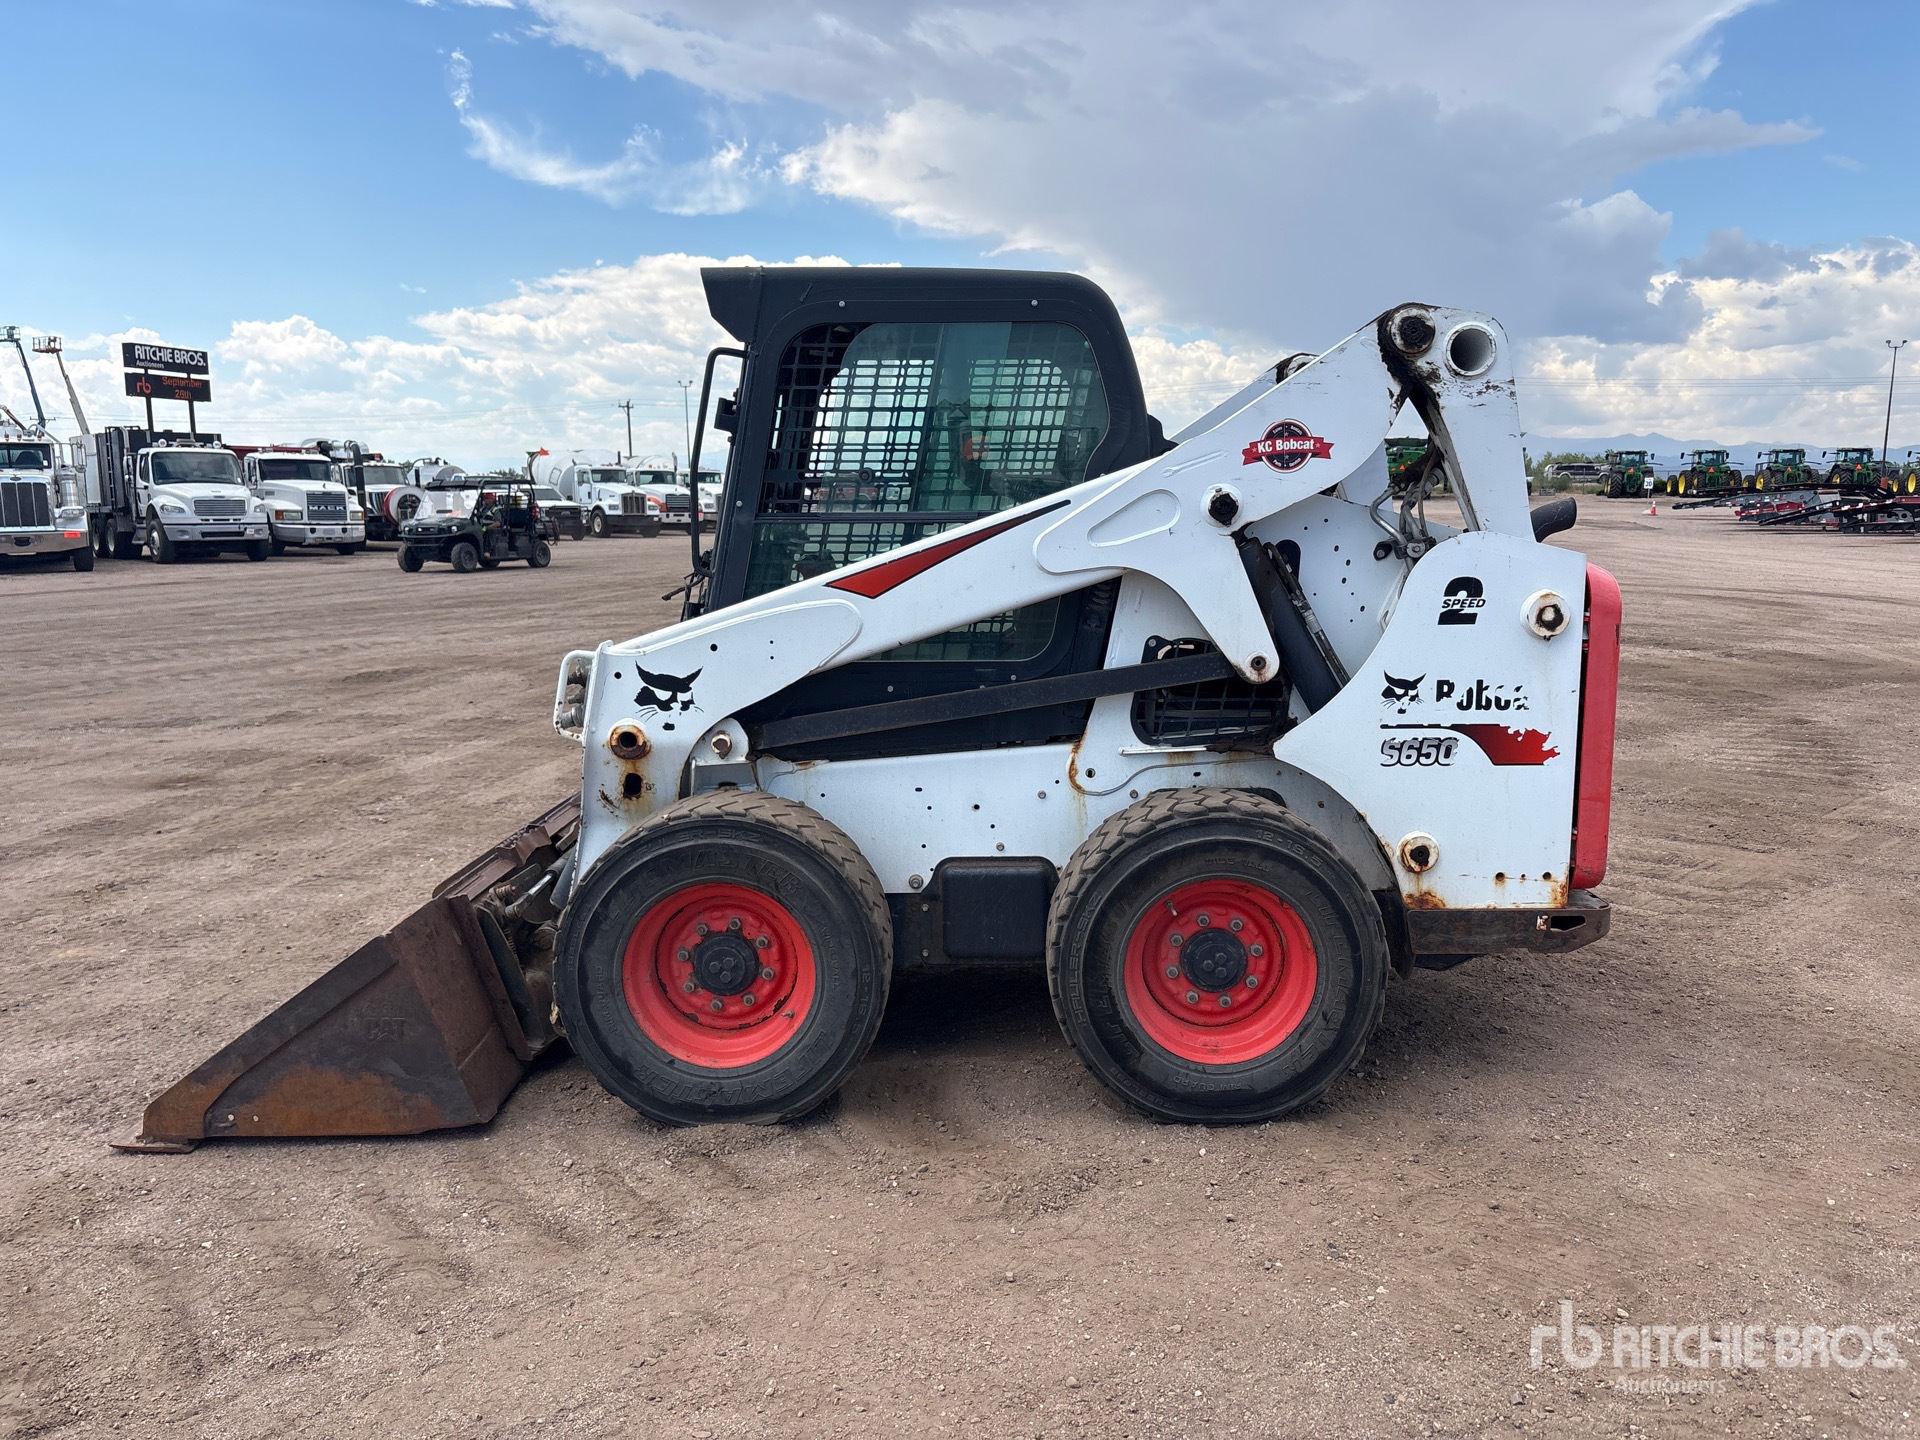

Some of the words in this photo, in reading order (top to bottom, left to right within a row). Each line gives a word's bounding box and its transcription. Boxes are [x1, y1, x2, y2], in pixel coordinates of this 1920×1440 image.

[135, 345, 173, 362] RITCHIE
[174, 351, 206, 367] BROS.
[136, 360, 165, 369] Auctioneers
[1257, 442, 1273, 454] KC
[1275, 439, 1314, 451] Bobcat
[1437, 575, 1484, 626] 2
[1441, 598, 1487, 609] SPEED
[1380, 737, 1459, 767] S650
